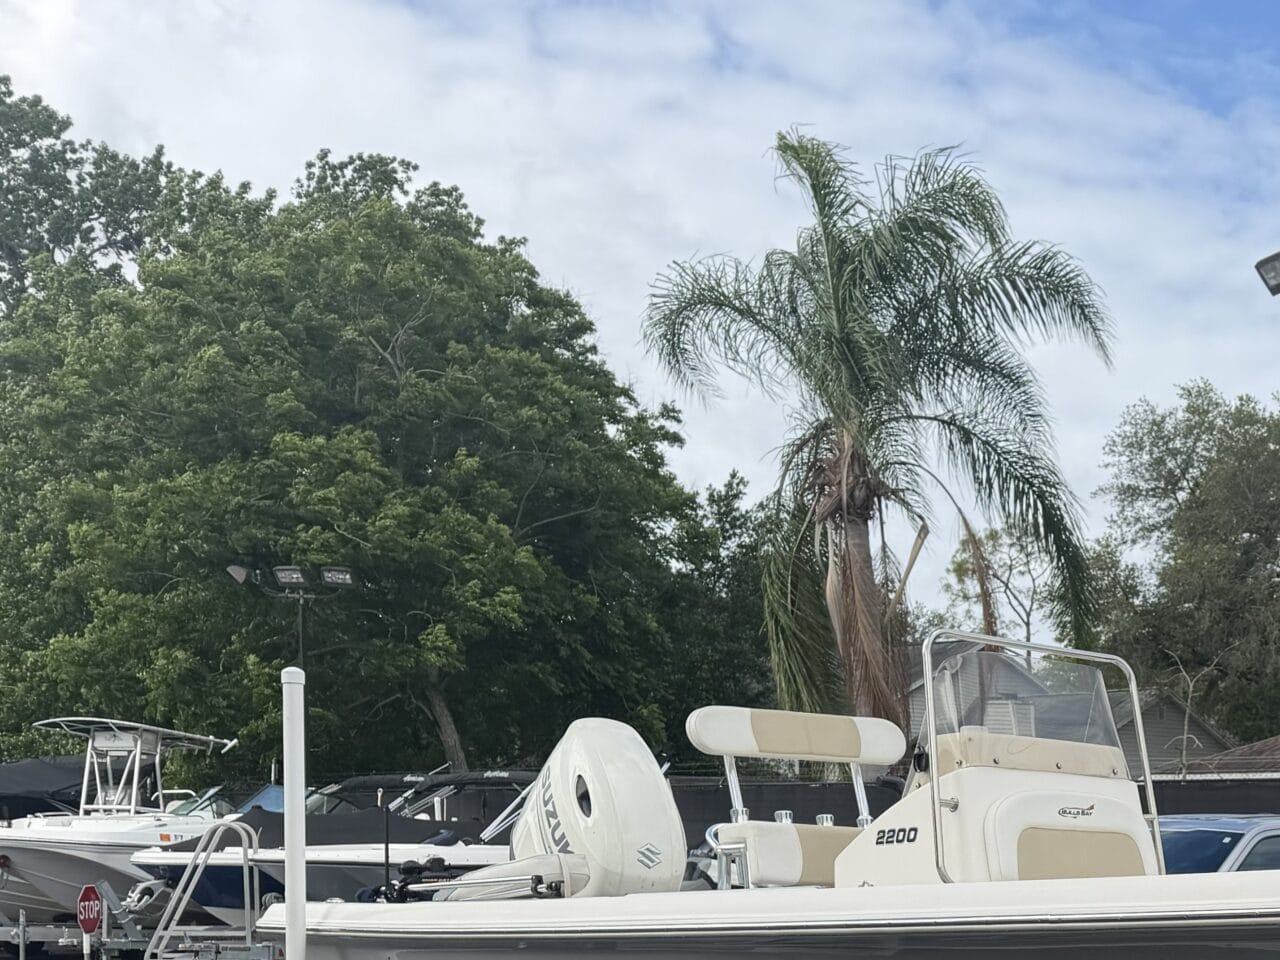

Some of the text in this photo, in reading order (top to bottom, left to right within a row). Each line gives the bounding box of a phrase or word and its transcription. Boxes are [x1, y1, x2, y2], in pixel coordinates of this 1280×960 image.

[541, 765, 575, 854] SUZUK
[876, 827, 918, 845] 2200
[79, 900, 100, 920] STOP
